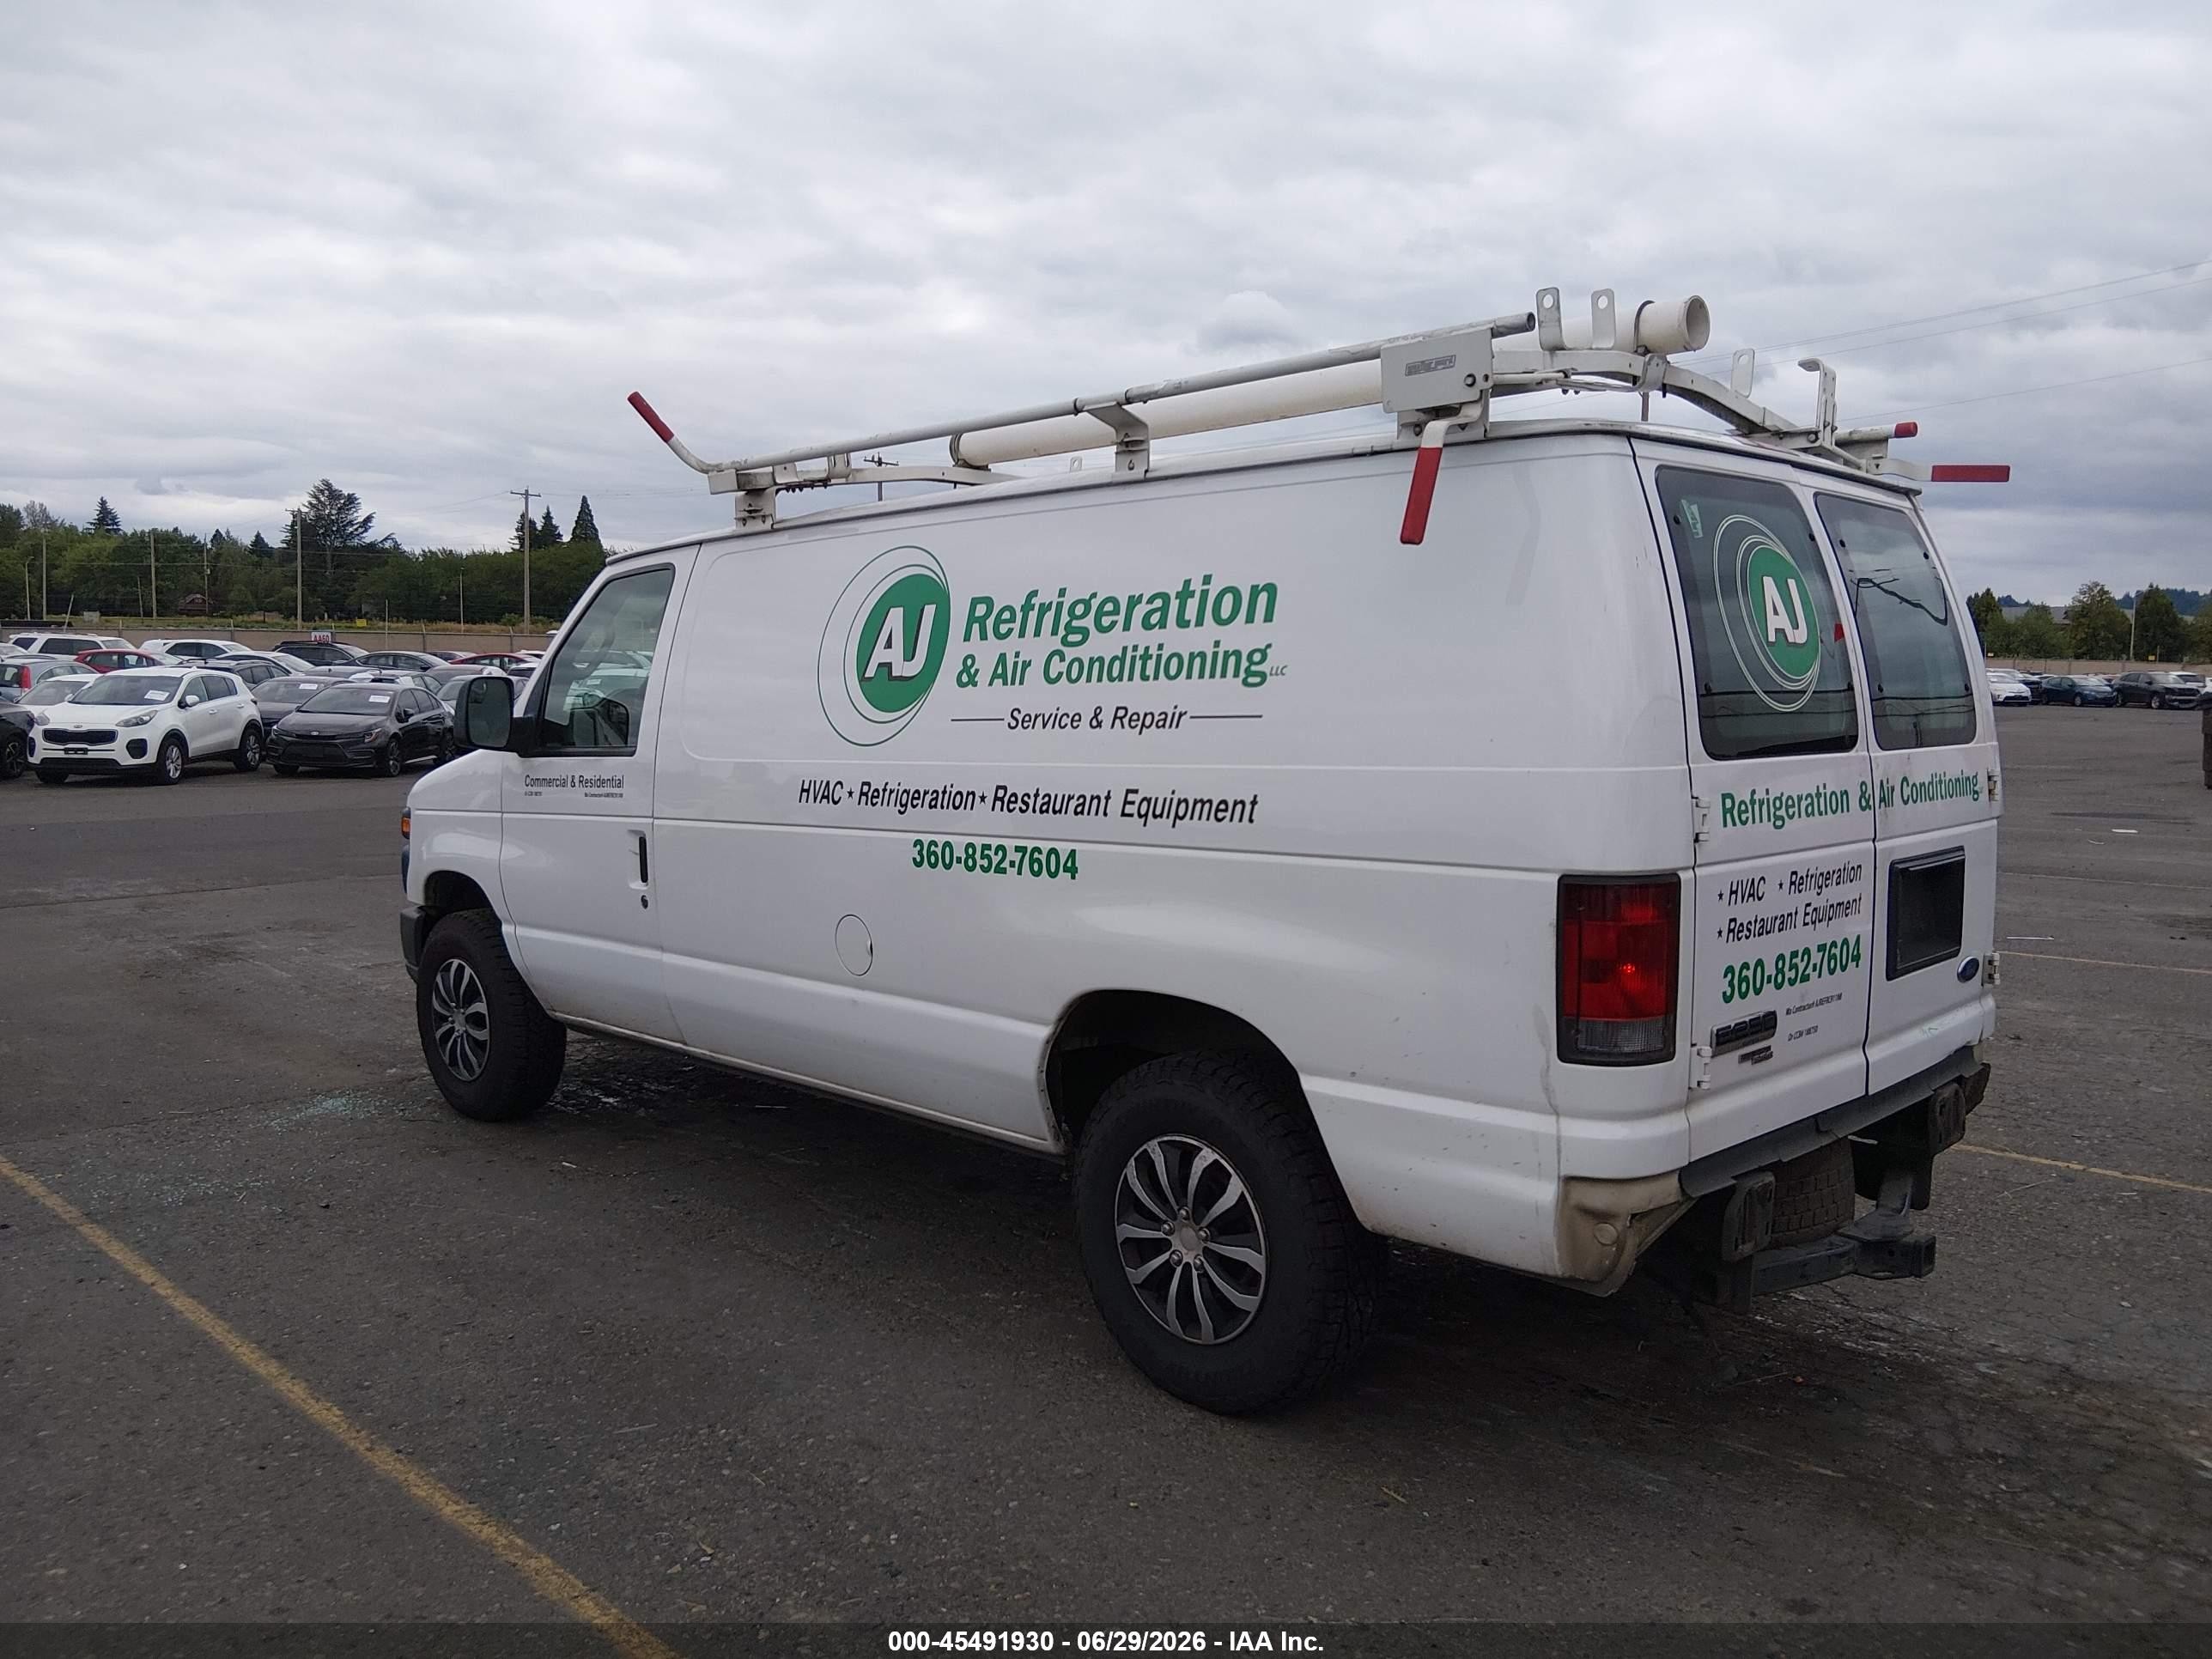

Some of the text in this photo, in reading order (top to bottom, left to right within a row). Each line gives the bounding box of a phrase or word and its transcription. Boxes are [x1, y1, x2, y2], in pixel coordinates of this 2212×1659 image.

[963, 574, 1278, 648] Refrigeration
[1762, 575, 1808, 644] AJ
[861, 604, 937, 681] AJ
[956, 640, 1289, 689] & Air Conditioning LLC
[1007, 704, 1188, 736] Service & Repair
[524, 774, 624, 789] Commercial & Residential
[798, 779, 1259, 830] HVAC Refrigeration Restaurant Equipment
[1721, 769, 1979, 830] Refrigeration & Air Conditioning
[911, 838, 1079, 881] 360-852-7604
[1728, 860, 1863, 907] HVAC Refrigeration
[1725, 893, 1863, 944] Restaurant Equipment
[1722, 933, 1862, 1005] 360-852-7604
